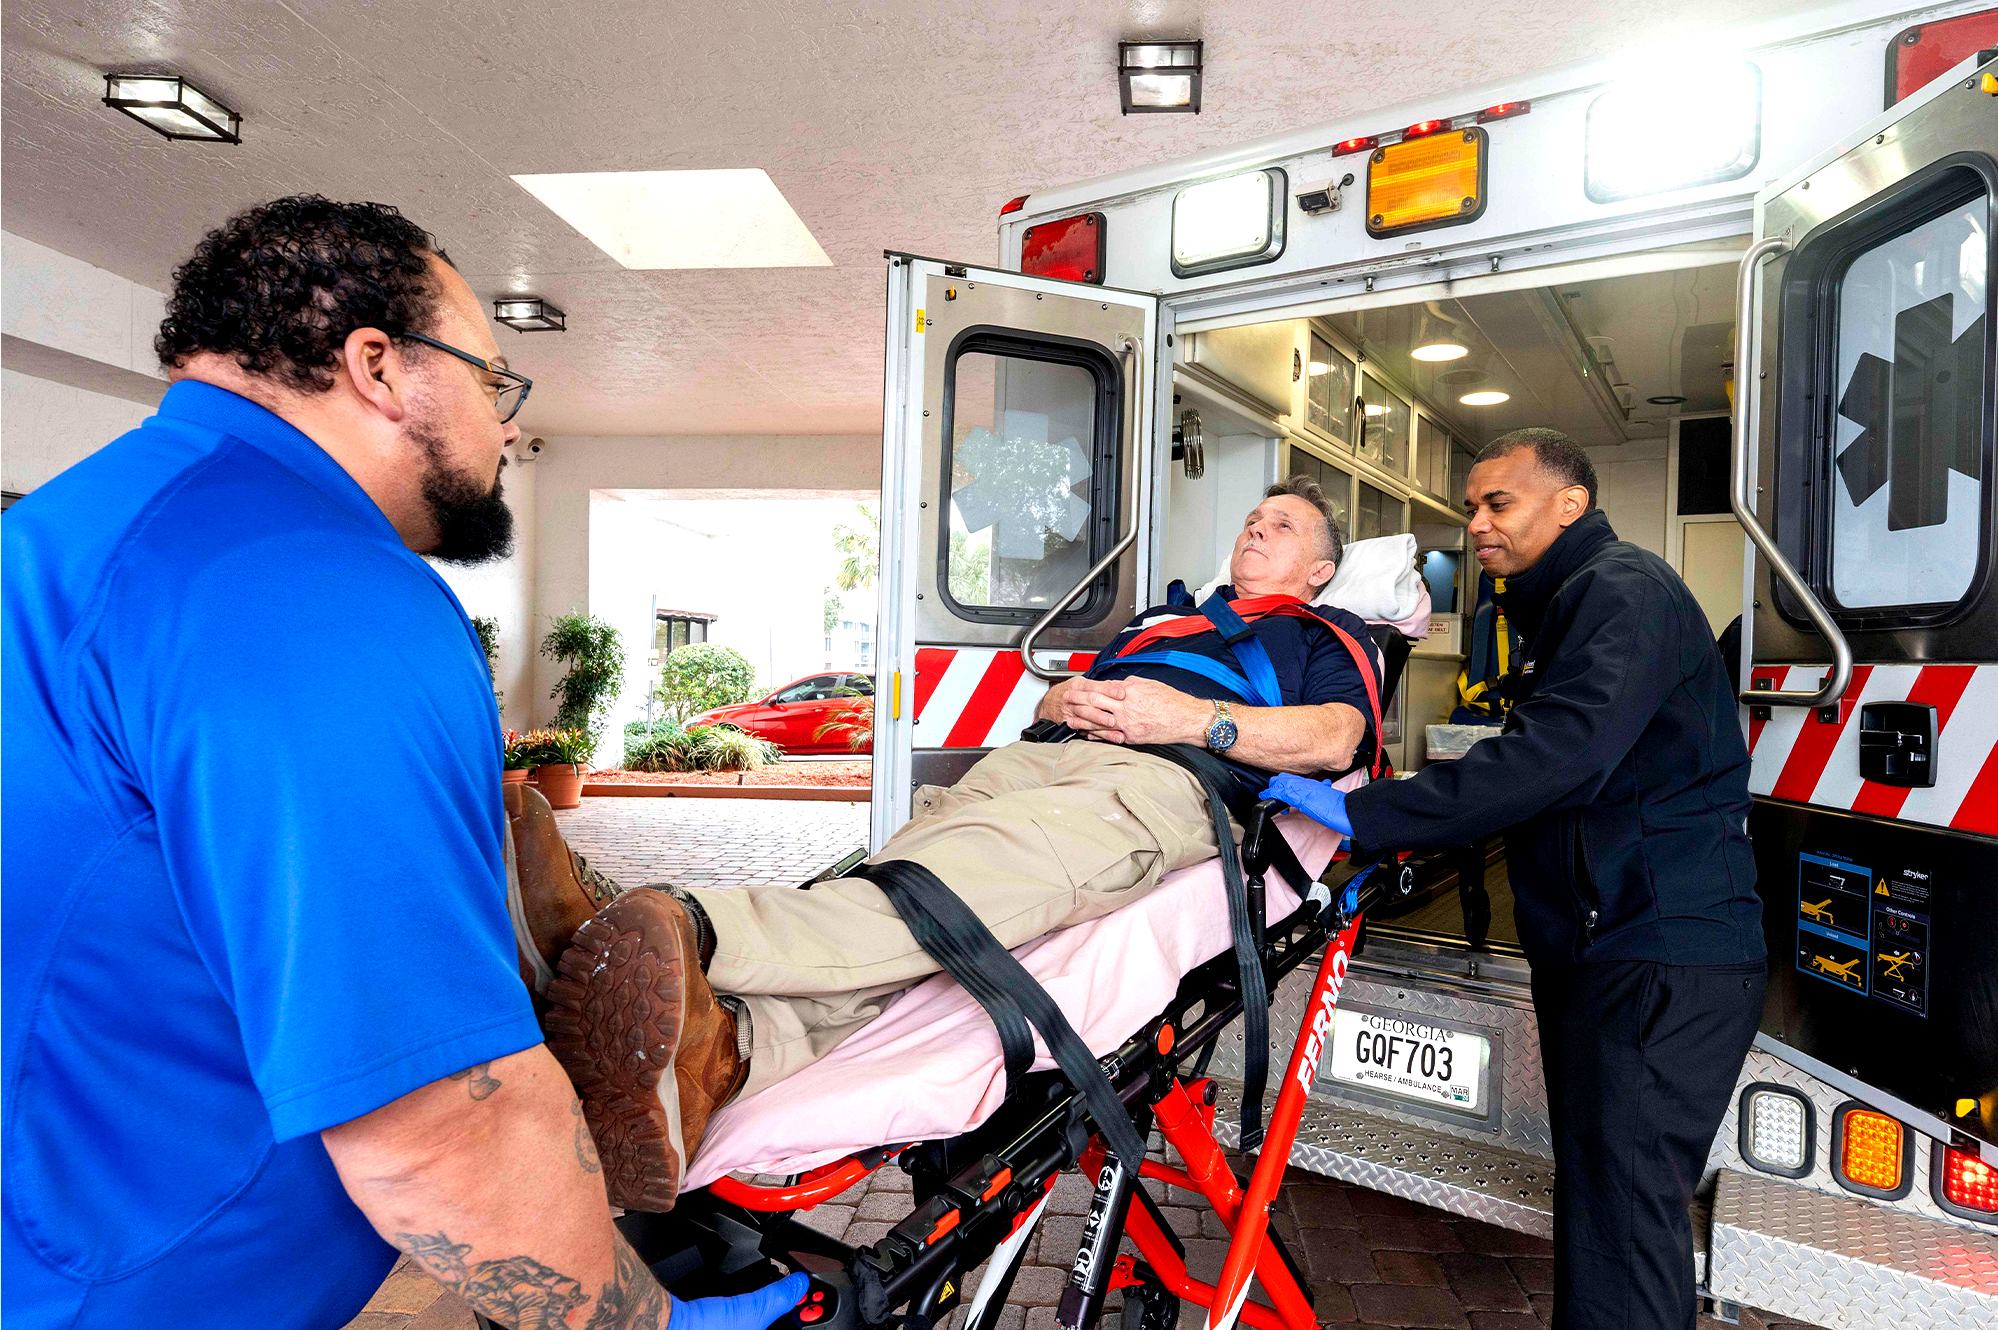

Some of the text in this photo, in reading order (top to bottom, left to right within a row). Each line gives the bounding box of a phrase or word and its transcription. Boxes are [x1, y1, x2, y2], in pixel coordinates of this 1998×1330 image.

[1903, 869, 1929, 880] stryker
[1886, 906, 1916, 920] Other Controls
[1297, 950, 1349, 1096] FERNO
[1370, 1015, 1446, 1043] GEORGIA
[1356, 1030, 1453, 1082] GQF703
[1364, 1069, 1393, 1082] HEARSE
[1397, 1077, 1442, 1094] AMBULANCE
